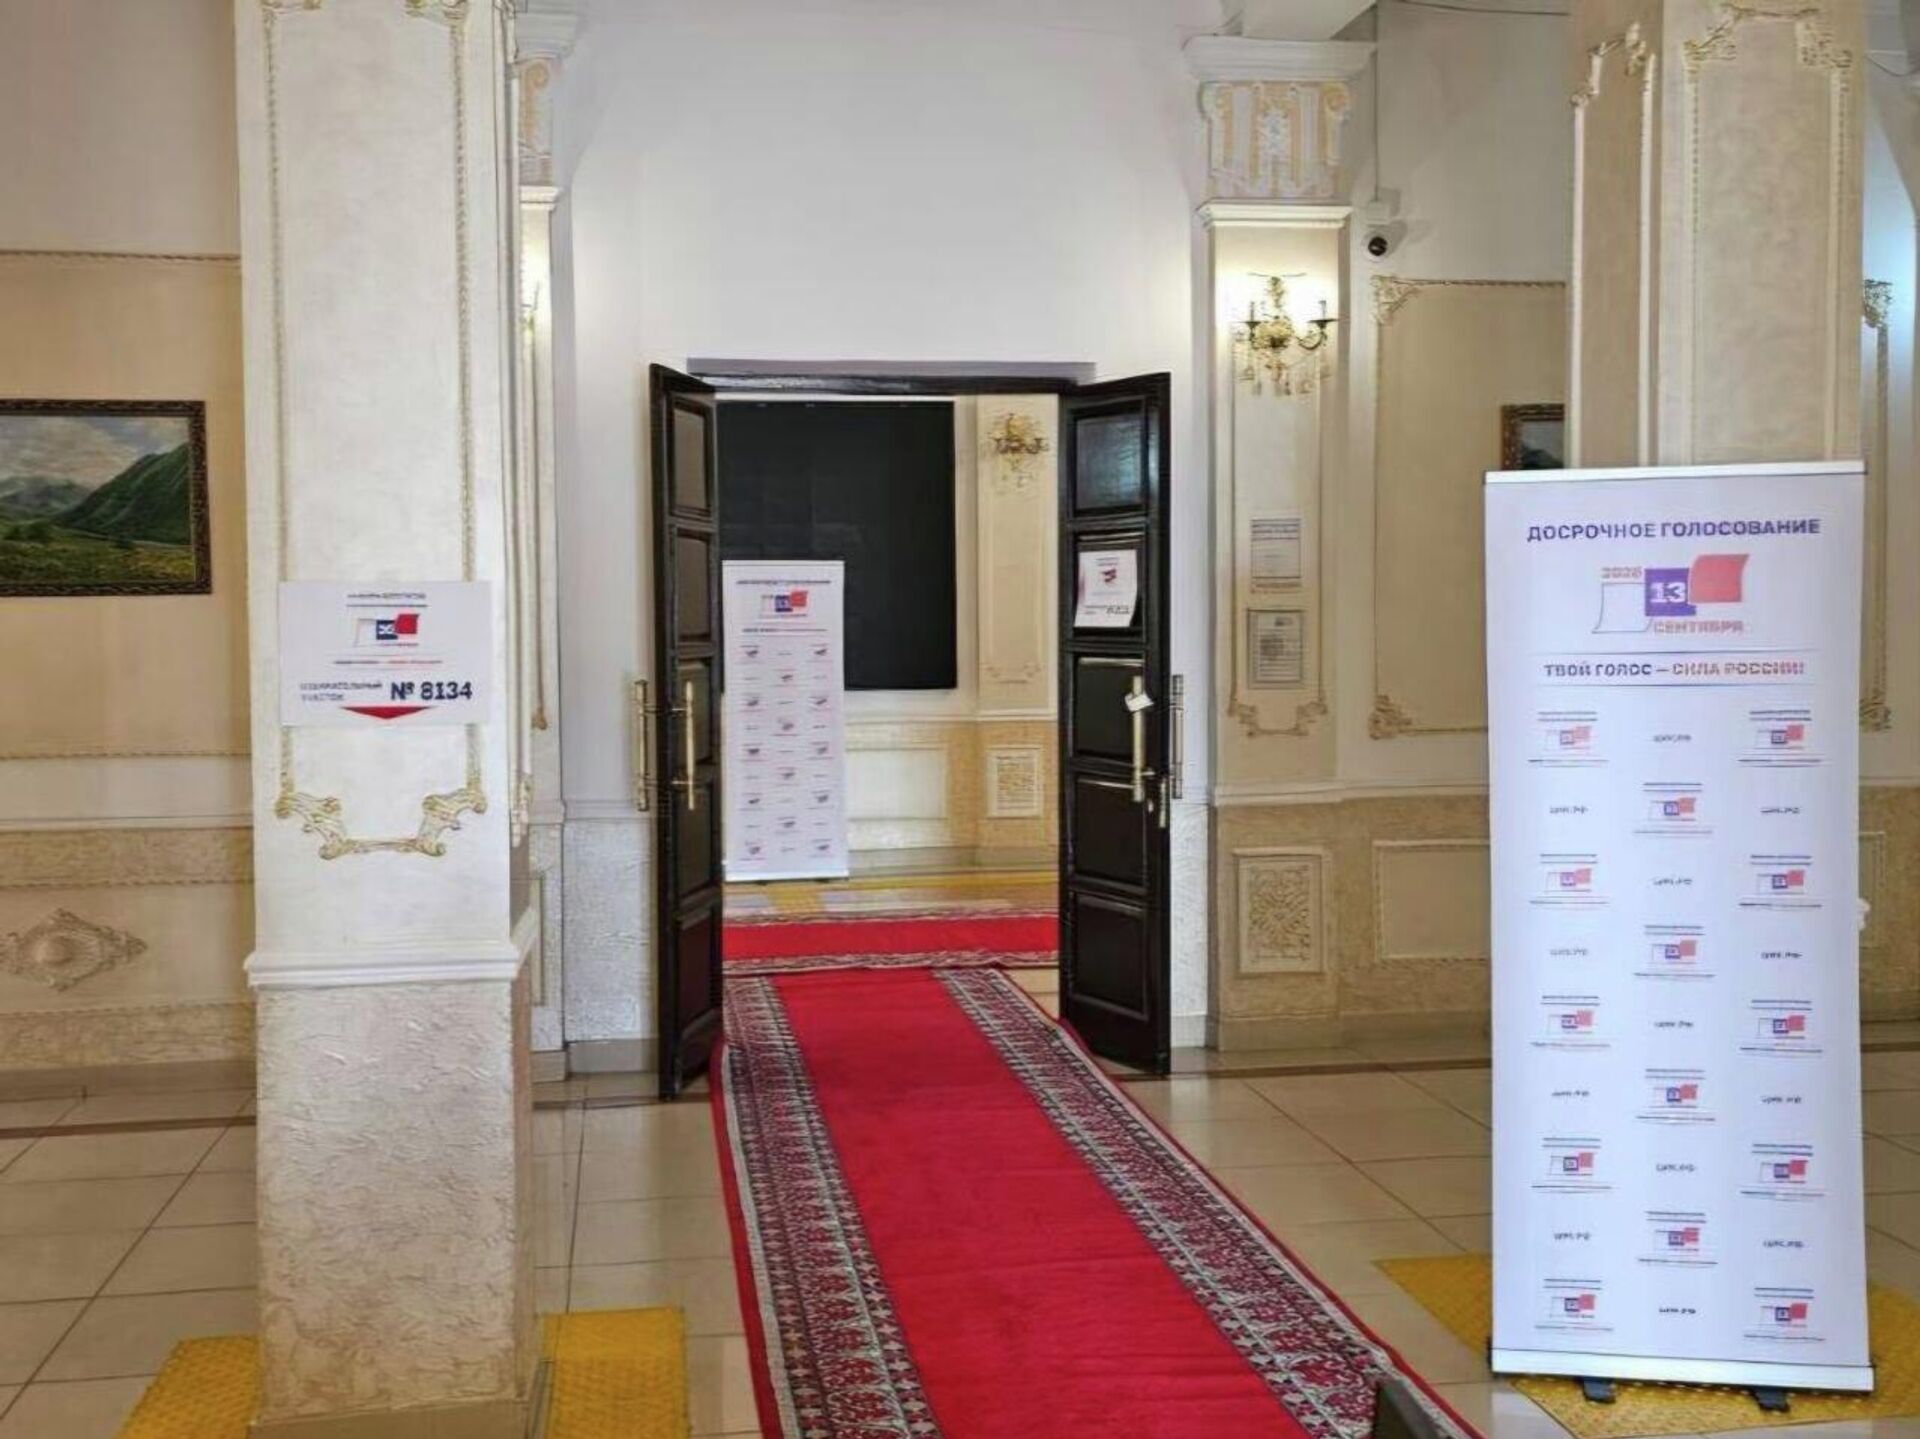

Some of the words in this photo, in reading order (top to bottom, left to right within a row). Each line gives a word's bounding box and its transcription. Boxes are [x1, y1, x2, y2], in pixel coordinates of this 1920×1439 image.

[1527, 523, 1656, 542] ДОСРОЧНОЕ
[1660, 519, 1821, 538] ГОЛОСОВАНИЕ
[1650, 582, 1687, 603] 13
[1544, 661, 1591, 677] ТВОЙ
[1595, 663, 1652, 676] ГОЛОС
[1672, 662, 1720, 676] СИЛА
[391, 682, 414, 700] №
[420, 681, 473, 700] 8134
